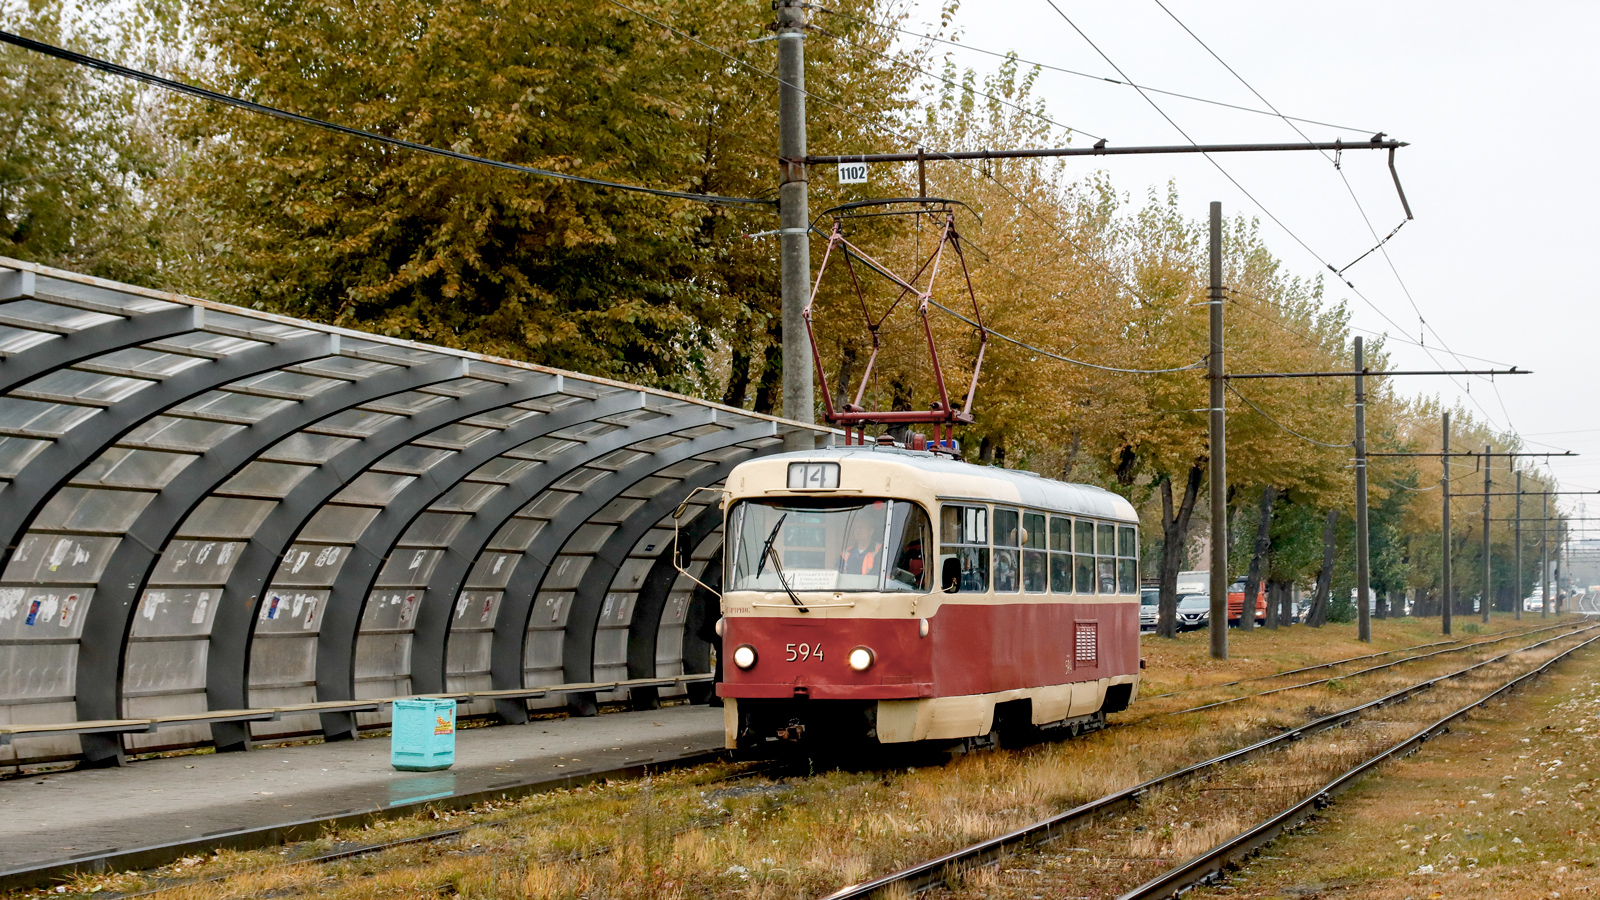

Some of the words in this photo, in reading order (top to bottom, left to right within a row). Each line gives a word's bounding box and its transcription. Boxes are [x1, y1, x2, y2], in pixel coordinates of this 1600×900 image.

[840, 166, 866, 180] 1102
[800, 465, 826, 488] 14
[786, 643, 824, 662] 594
